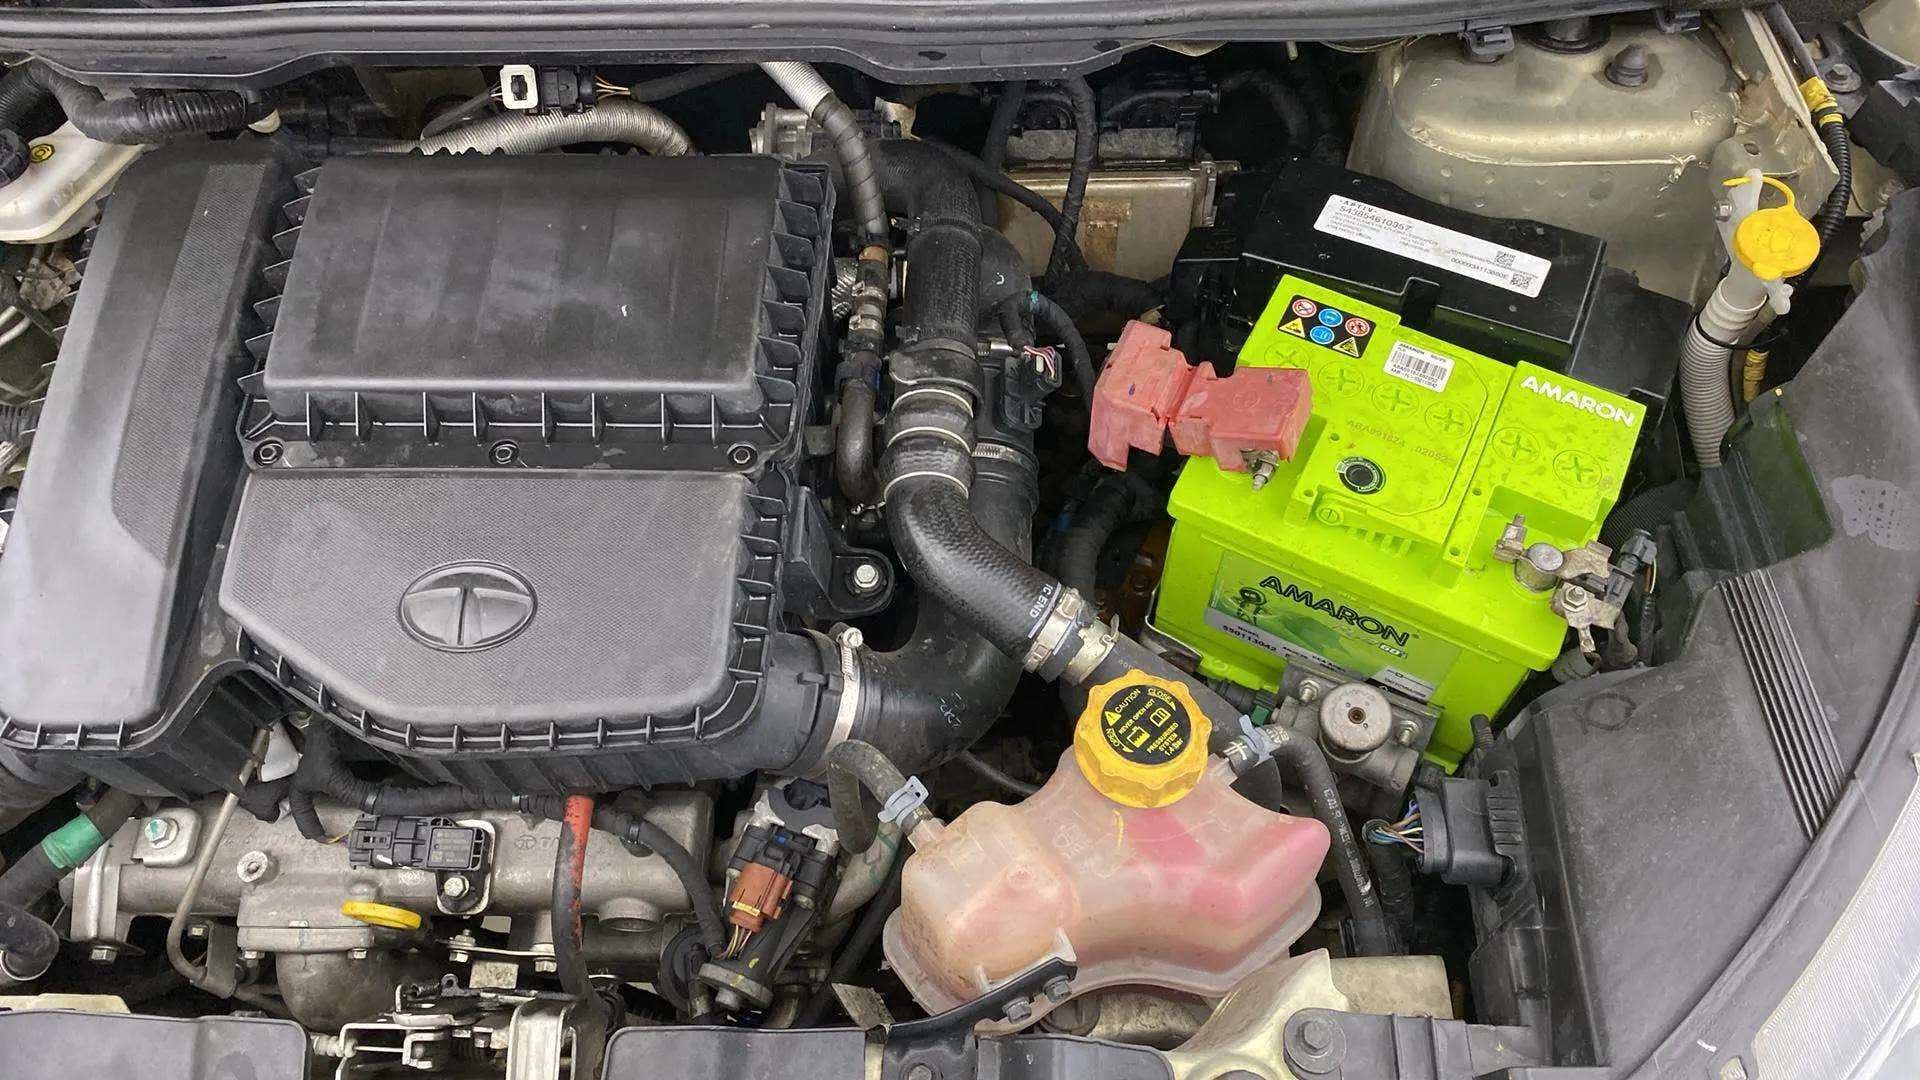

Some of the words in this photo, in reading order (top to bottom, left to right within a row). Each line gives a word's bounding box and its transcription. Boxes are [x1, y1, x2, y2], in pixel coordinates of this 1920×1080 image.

[1520, 375, 1634, 427] AMARON
[1029, 594, 1049, 618] END
[1259, 575, 1409, 647] AMARON
[1114, 688, 1142, 713] CAUTION
[1147, 687, 1173, 703] CLOSE
[1118, 718, 1136, 735] NEVER
[1132, 707, 1147, 721] OPEN
[1144, 698, 1156, 710] HOT
[1158, 732, 1178, 752] SYSTEM
